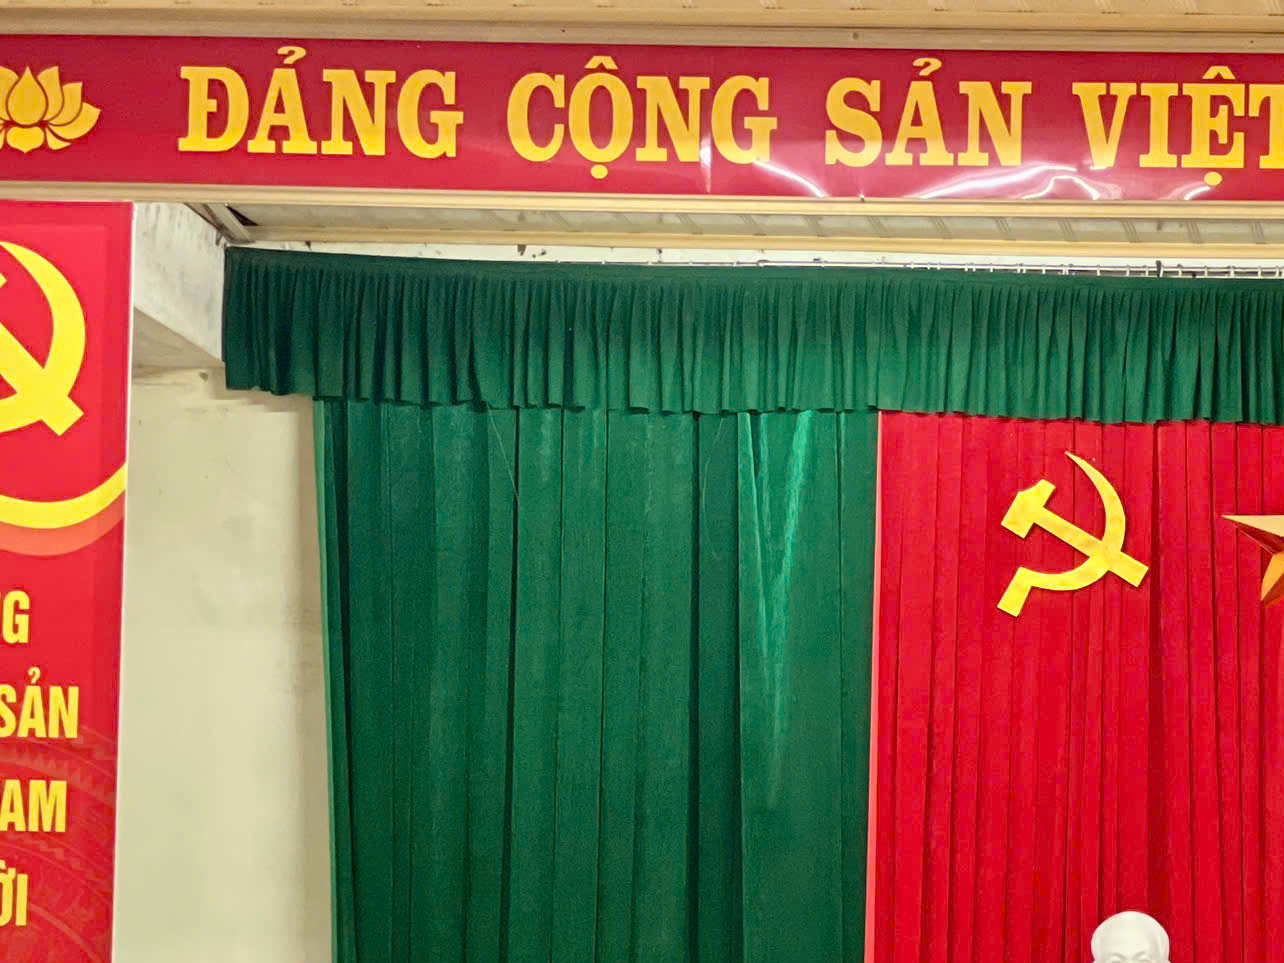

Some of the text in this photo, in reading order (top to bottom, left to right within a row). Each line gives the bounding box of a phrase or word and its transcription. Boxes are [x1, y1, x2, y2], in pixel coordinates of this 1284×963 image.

[178, 46, 464, 159] ĐẢNG
[507, 56, 778, 180] CỘNG
[825, 58, 1033, 167] SẢN
